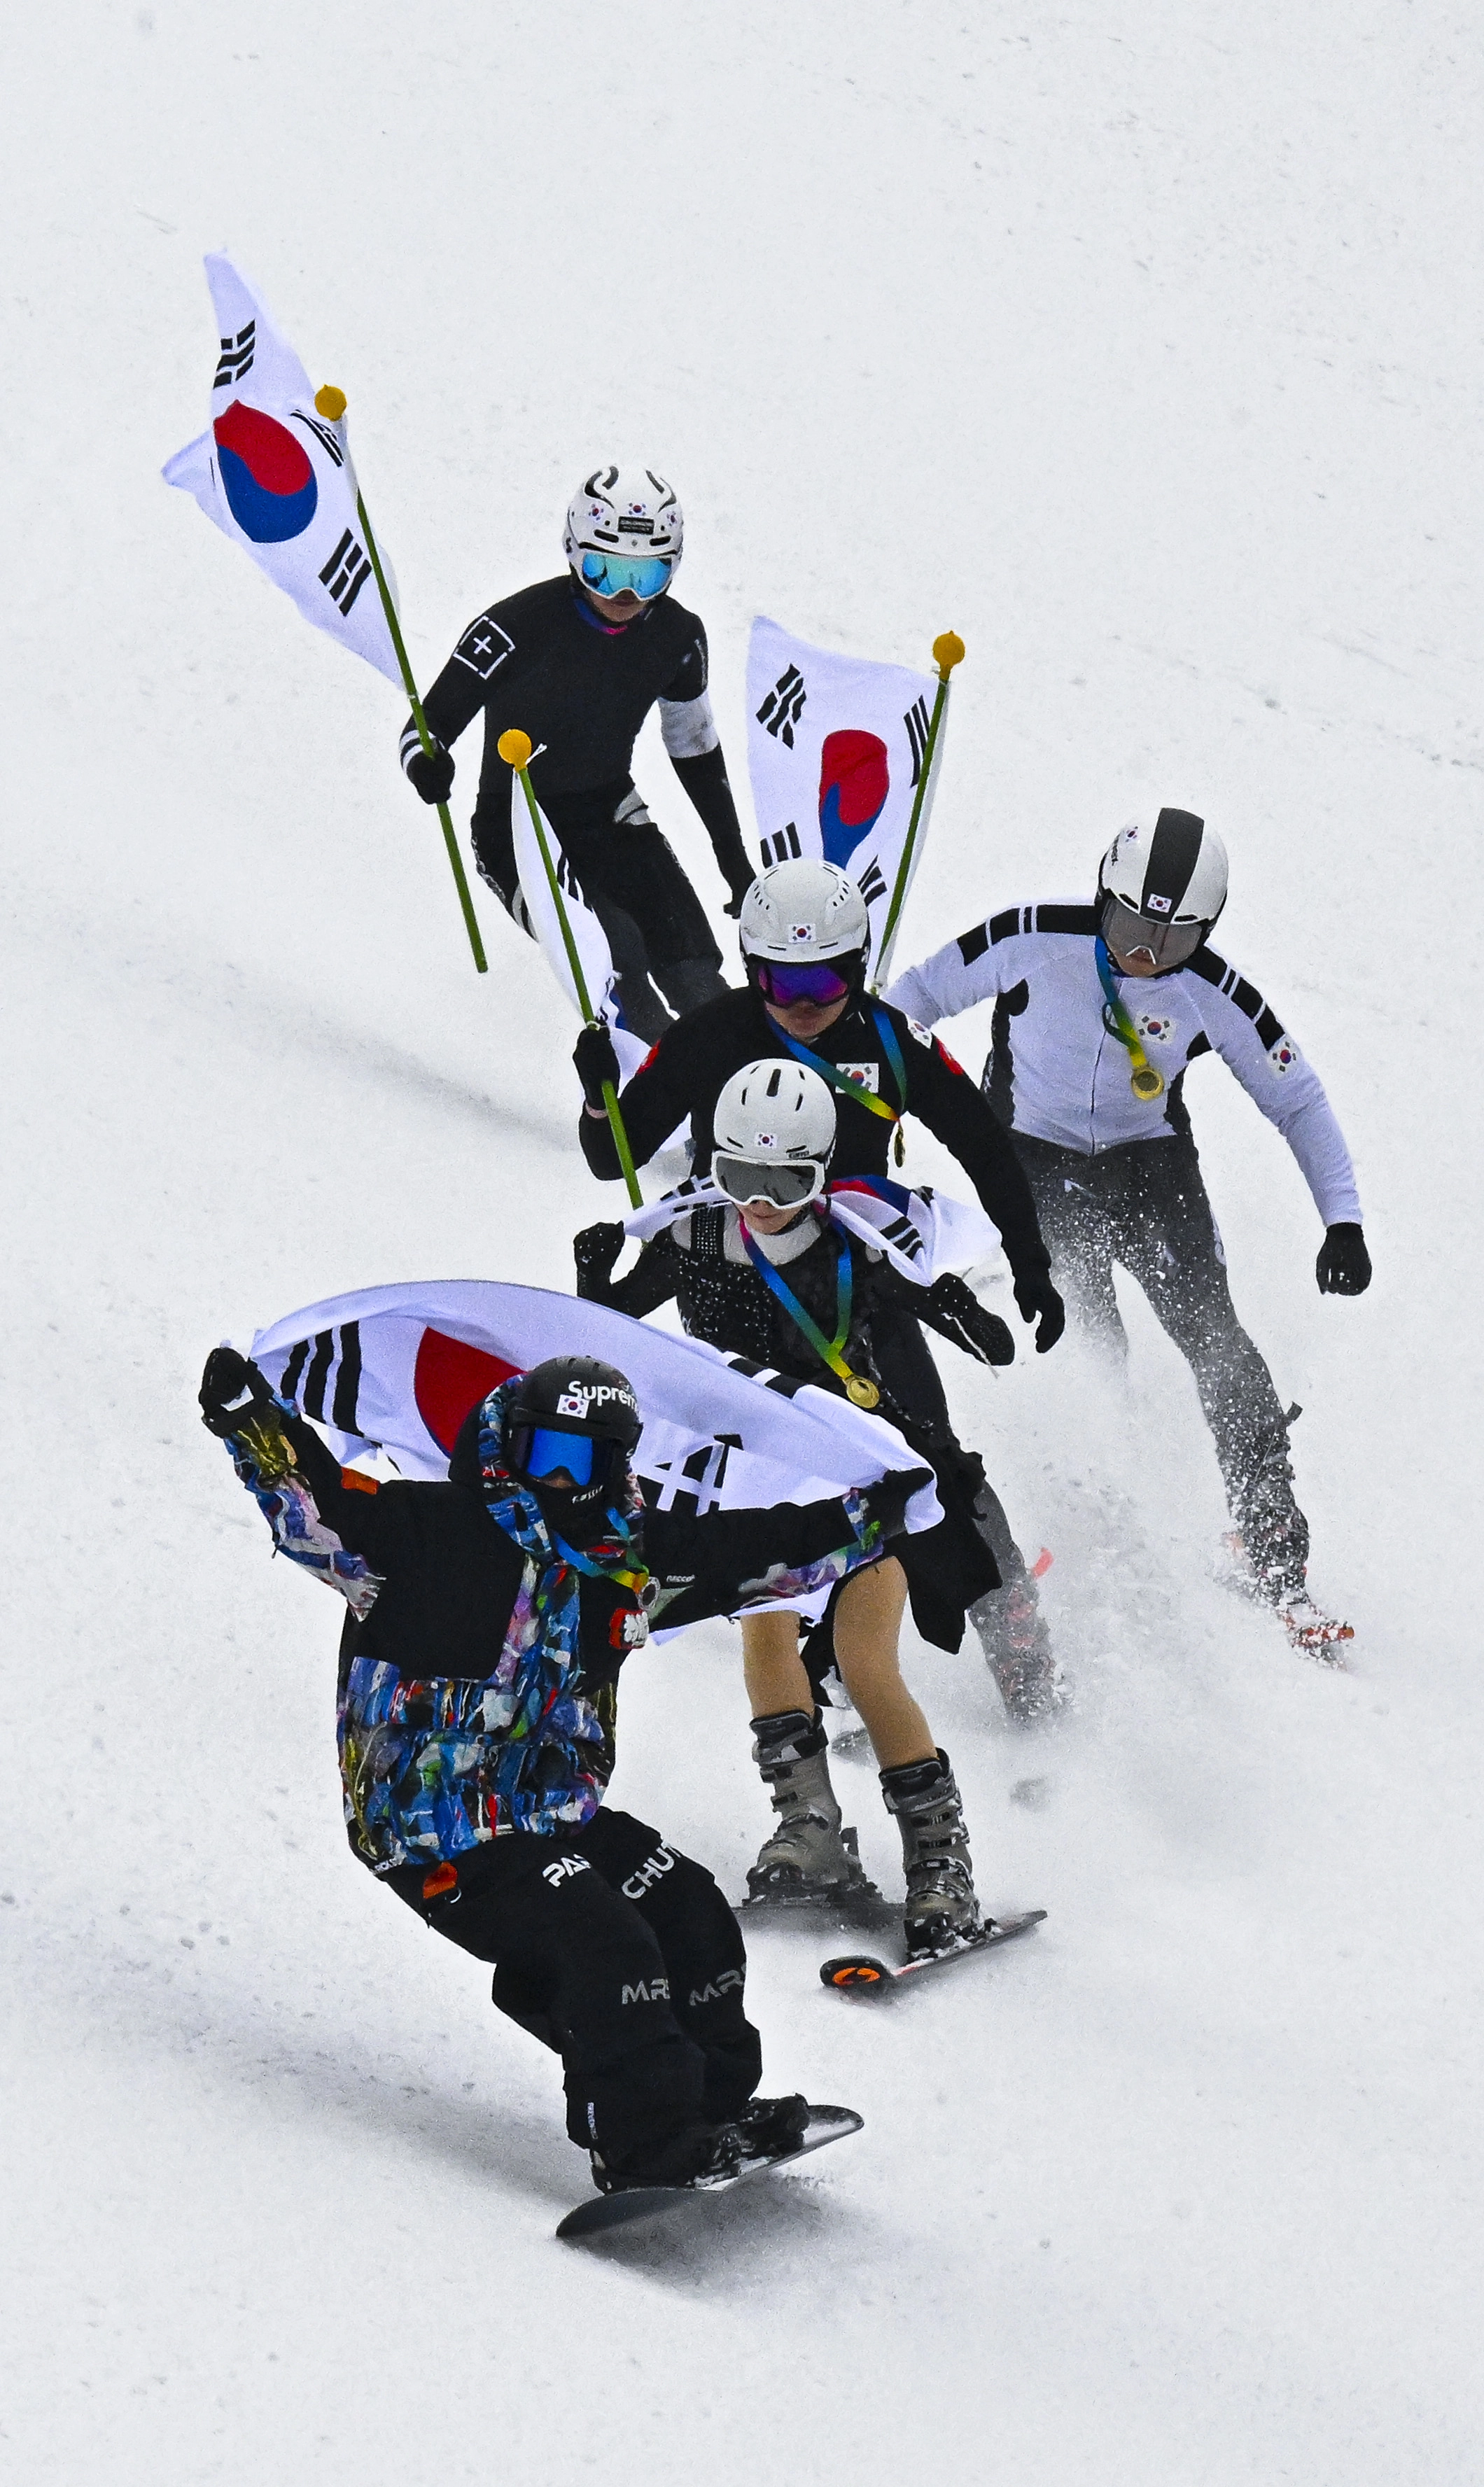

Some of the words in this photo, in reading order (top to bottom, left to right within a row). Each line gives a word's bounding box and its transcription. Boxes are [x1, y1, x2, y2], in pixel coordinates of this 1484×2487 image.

[568, 1380, 640, 1417] Suprem
[622, 1978, 671, 2005] MR
[689, 1963, 747, 2006] MR
